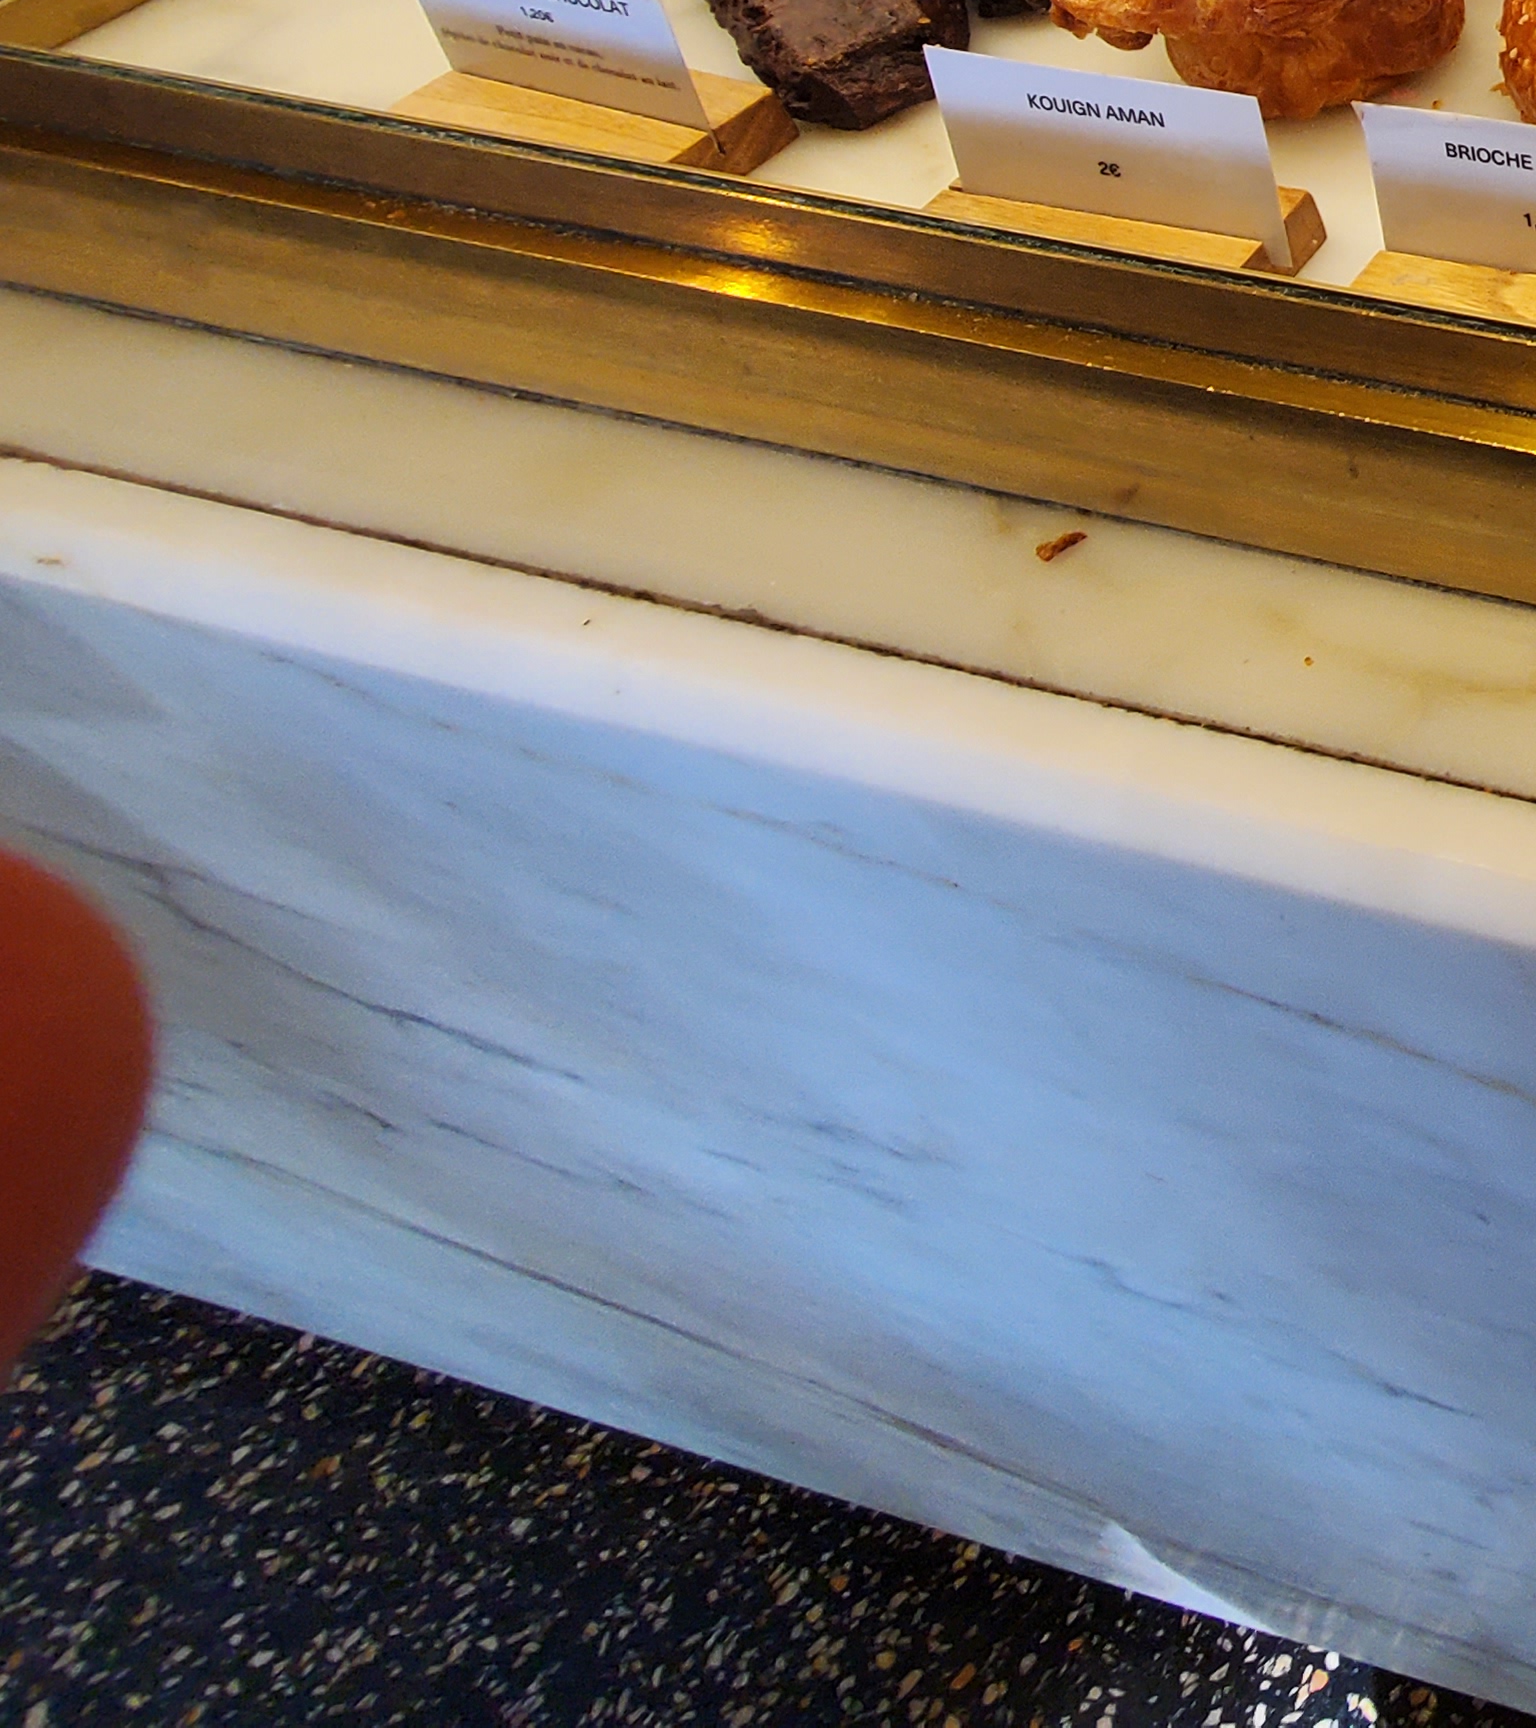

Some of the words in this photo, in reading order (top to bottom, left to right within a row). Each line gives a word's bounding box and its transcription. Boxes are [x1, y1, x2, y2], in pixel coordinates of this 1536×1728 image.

[1026, 92, 1101, 119] KOUIGN
[1105, 105, 1166, 128] AMAN
[1097, 160, 1122, 178] 2€
[1443, 141, 1534, 171] BRIOCHE
